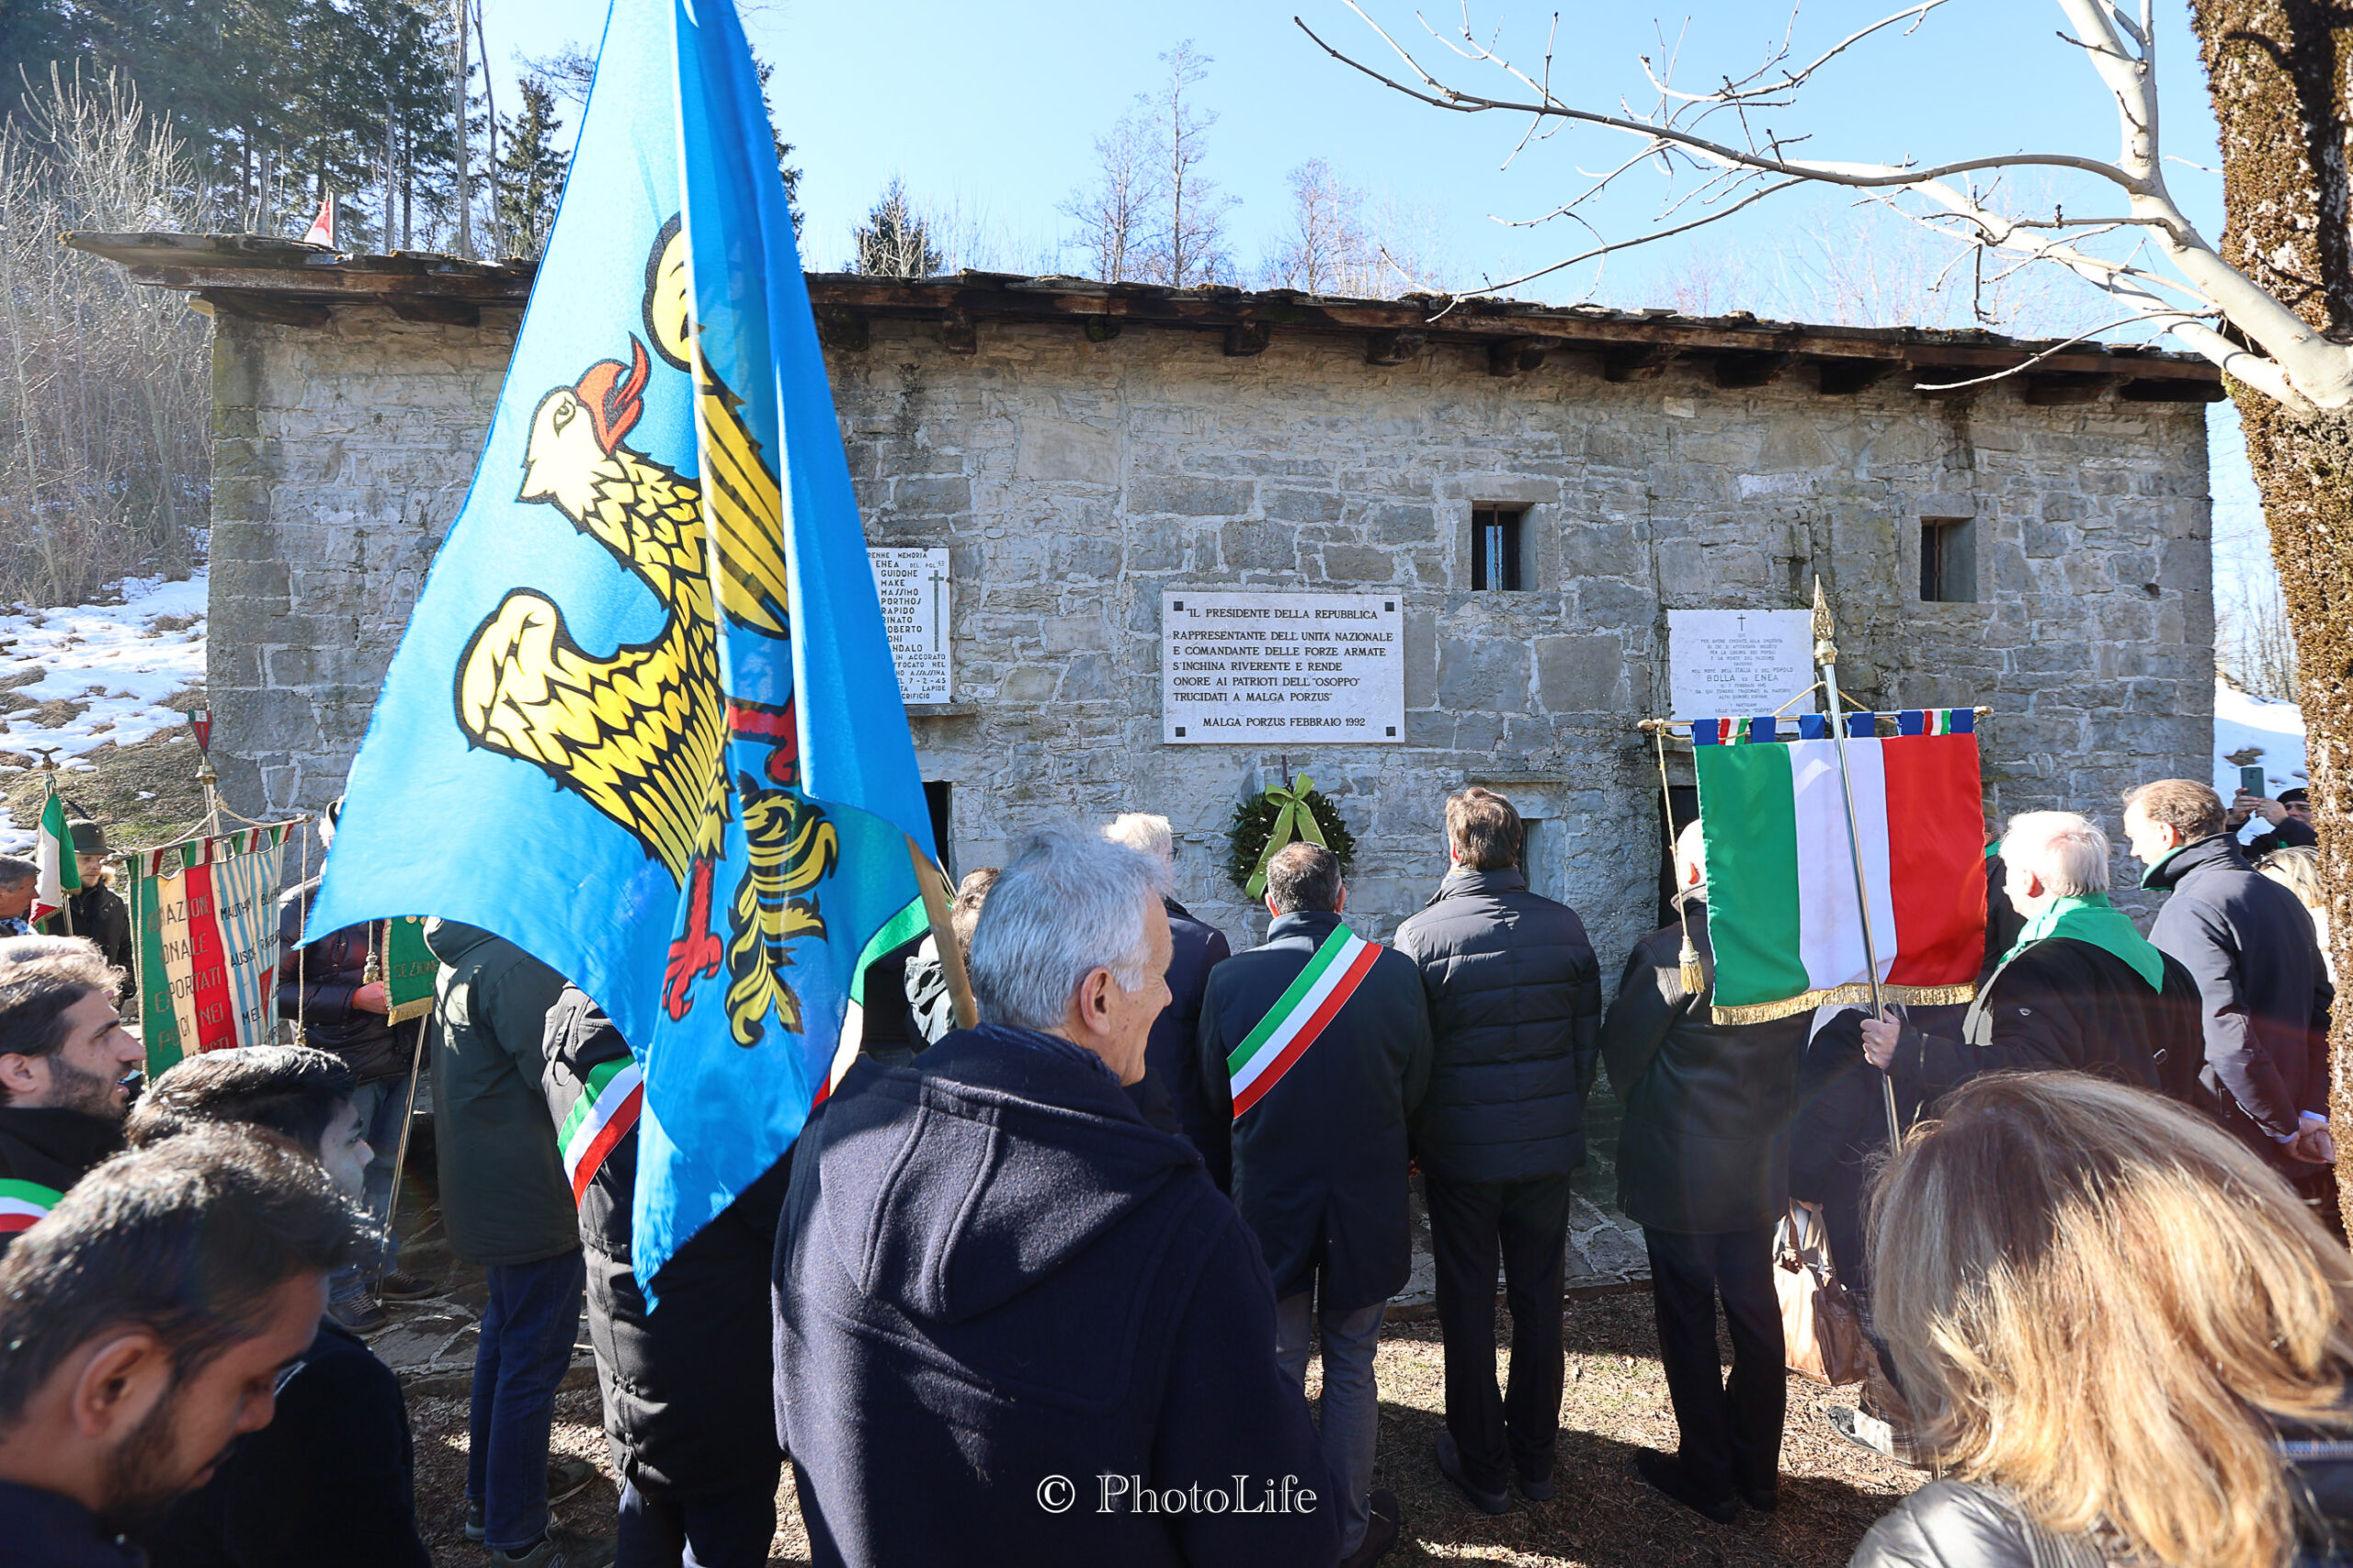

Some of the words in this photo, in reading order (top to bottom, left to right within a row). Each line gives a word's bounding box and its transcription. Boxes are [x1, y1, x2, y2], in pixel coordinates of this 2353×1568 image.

[881, 588, 918, 597] MASSIMO
[881, 607, 915, 615] RAPIDO
[1206, 608, 1270, 618] PRESIDENTE
[1275, 609, 1310, 619] DELLA
[1315, 609, 1378, 619] REPUBBLICA
[1173, 631, 1267, 641] RAPPRESENTANTE
[1335, 632, 1393, 642] NAZIONALE
[1173, 646, 1180, 655] E
[1185, 646, 1259, 655] COMANDANTE
[1265, 647, 1300, 656] DELLE
[1305, 647, 1338, 656] FORZE
[1344, 648, 1386, 656] ARMATE
[1173, 662, 1225, 671] S'INCHINA
[1231, 662, 1291, 671] RIVERENTE
[1296, 663, 1302, 671] E
[1308, 663, 1343, 672] RENDE
[1173, 676, 1211, 686] ONORE
[1216, 677, 1227, 686] AI
[1233, 677, 1278, 687] PATRIOTI
[1755, 674, 1779, 682] ENEA
[1174, 692, 1228, 701] TRUCIDATI
[1233, 692, 1241, 701] A
[1246, 692, 1285, 702] MALGA
[1203, 717, 1242, 727] MALGA
[1246, 717, 1286, 727] PORZUS
[1290, 717, 1342, 727] FEBBRAIO
[1346, 717, 1366, 727] 1992
[199, 1001, 224, 1028] NEI
